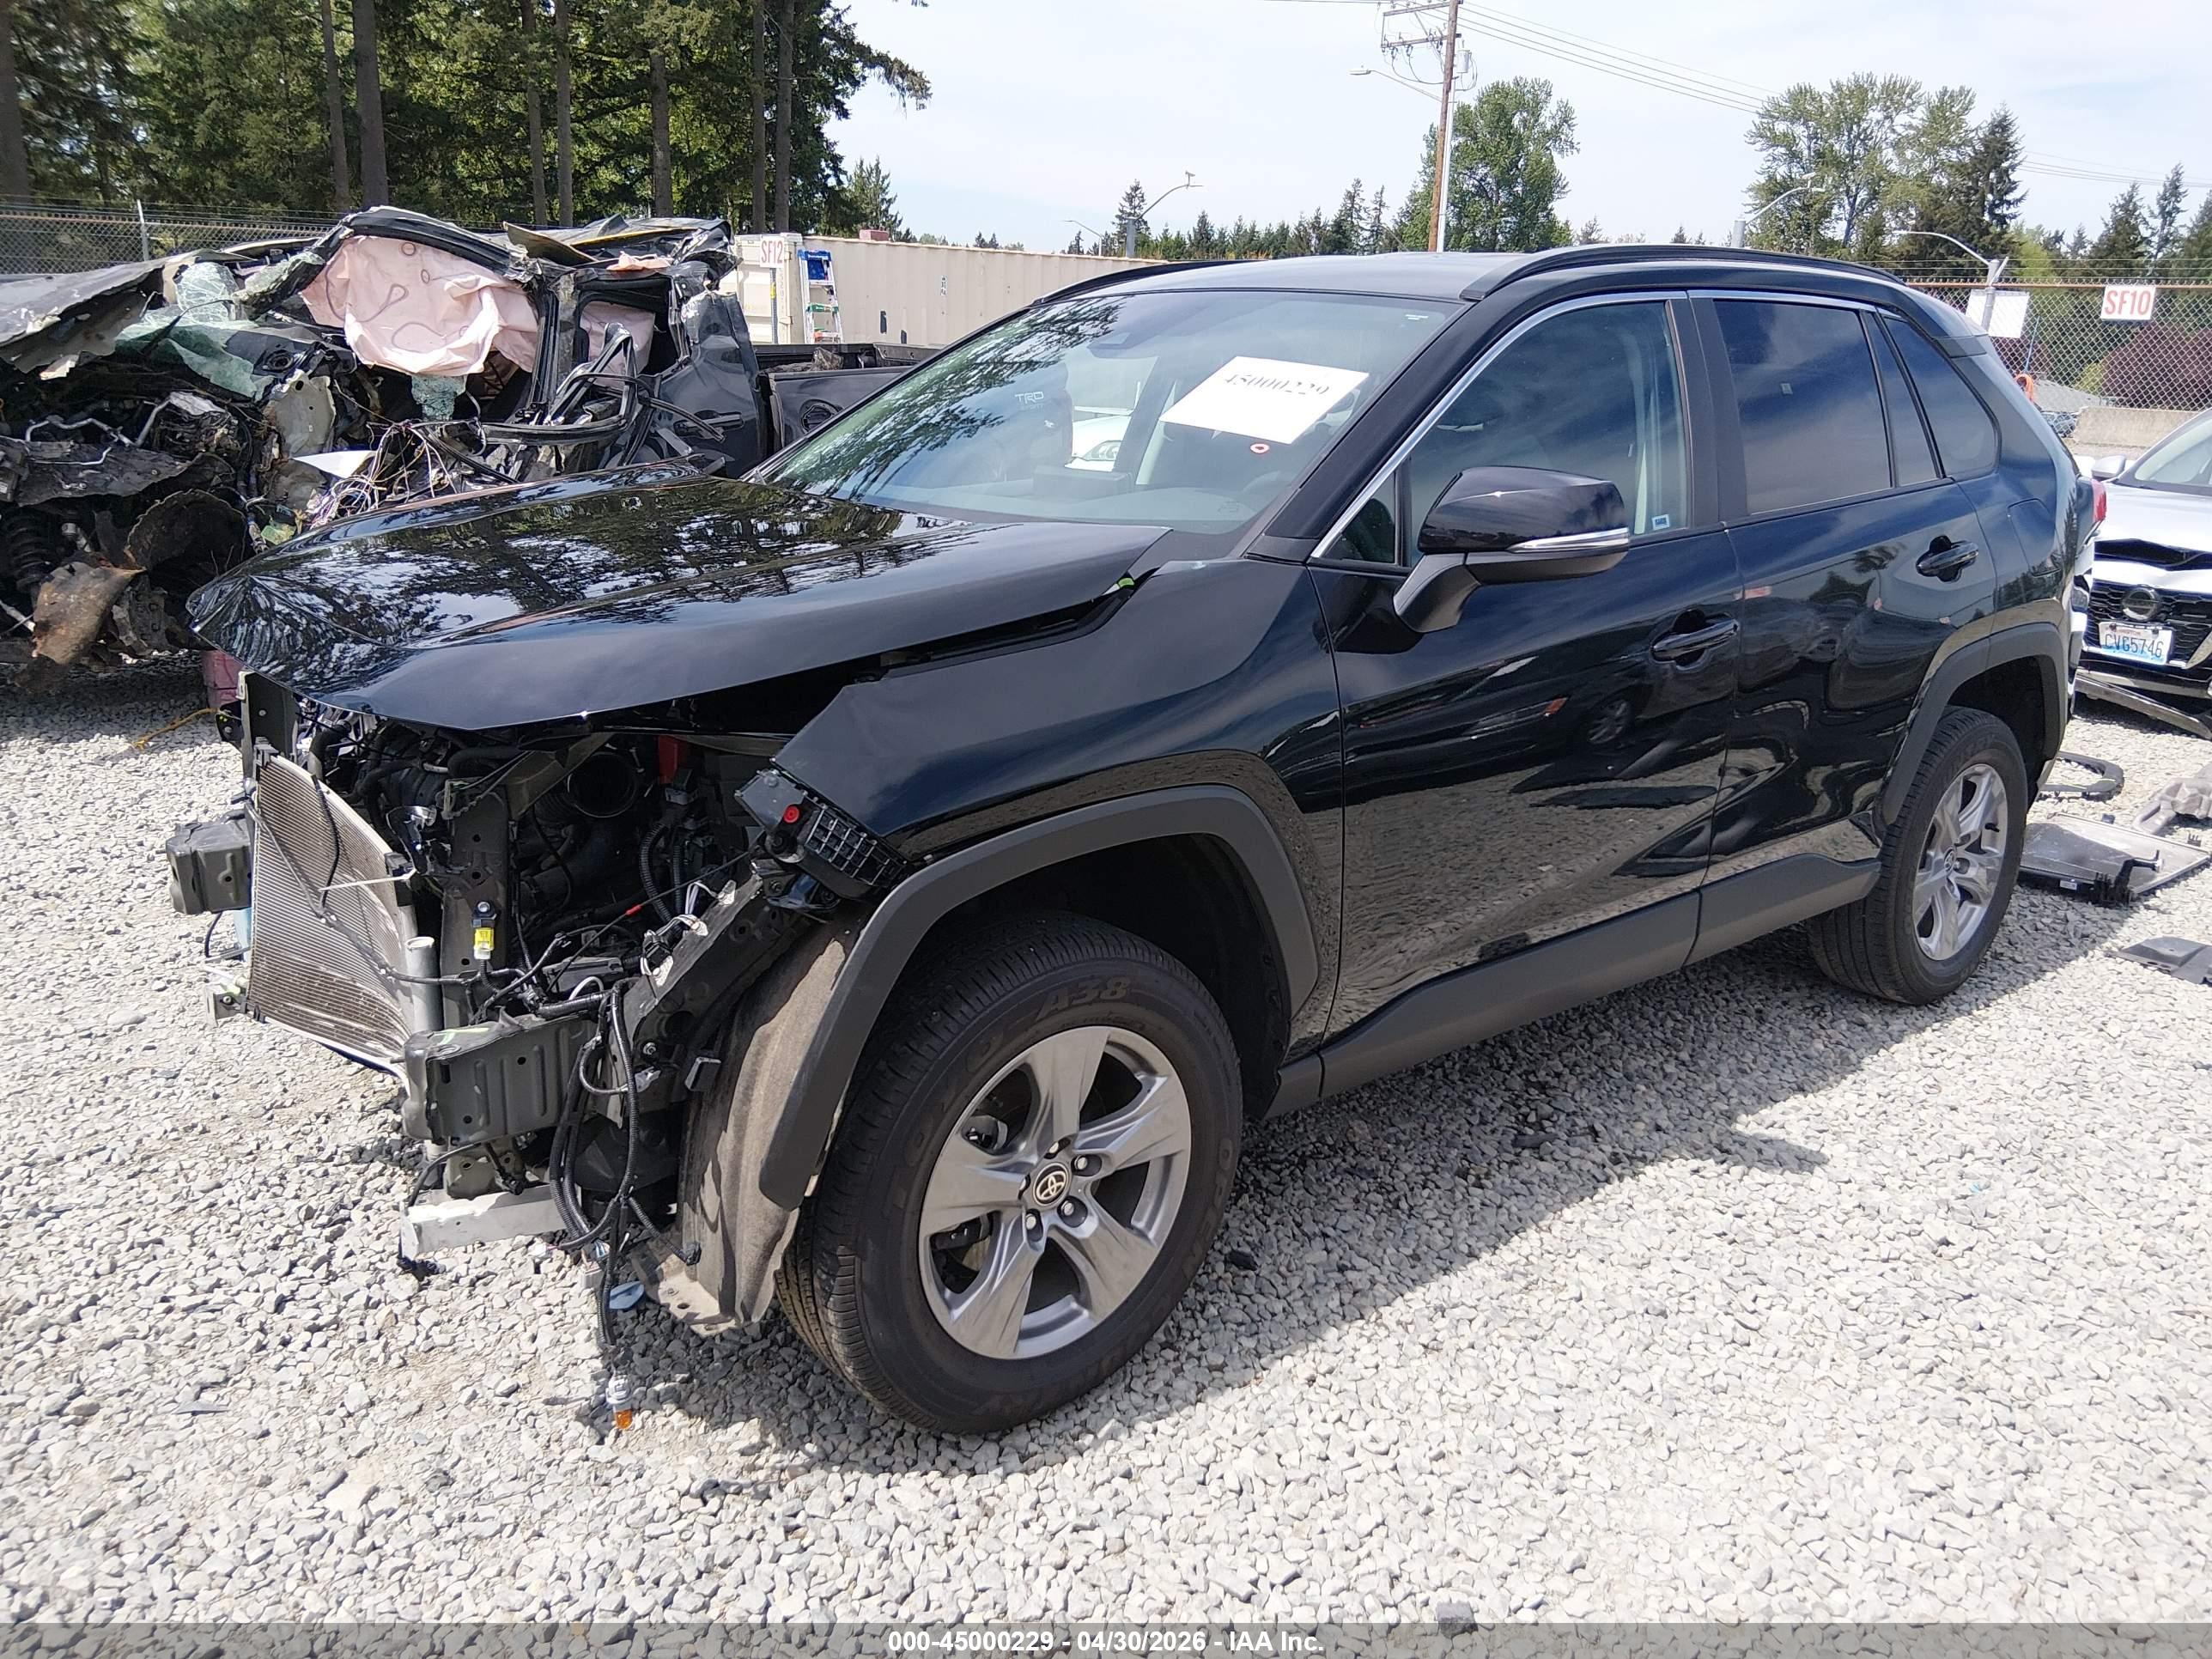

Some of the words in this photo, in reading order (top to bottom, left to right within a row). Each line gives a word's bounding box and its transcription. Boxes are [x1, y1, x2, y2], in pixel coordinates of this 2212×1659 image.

[761, 240, 783, 264] SF12
[2104, 290, 2151, 315] SF10
[1014, 391, 1044, 404] TRD
[1035, 976, 1132, 1022] A38
